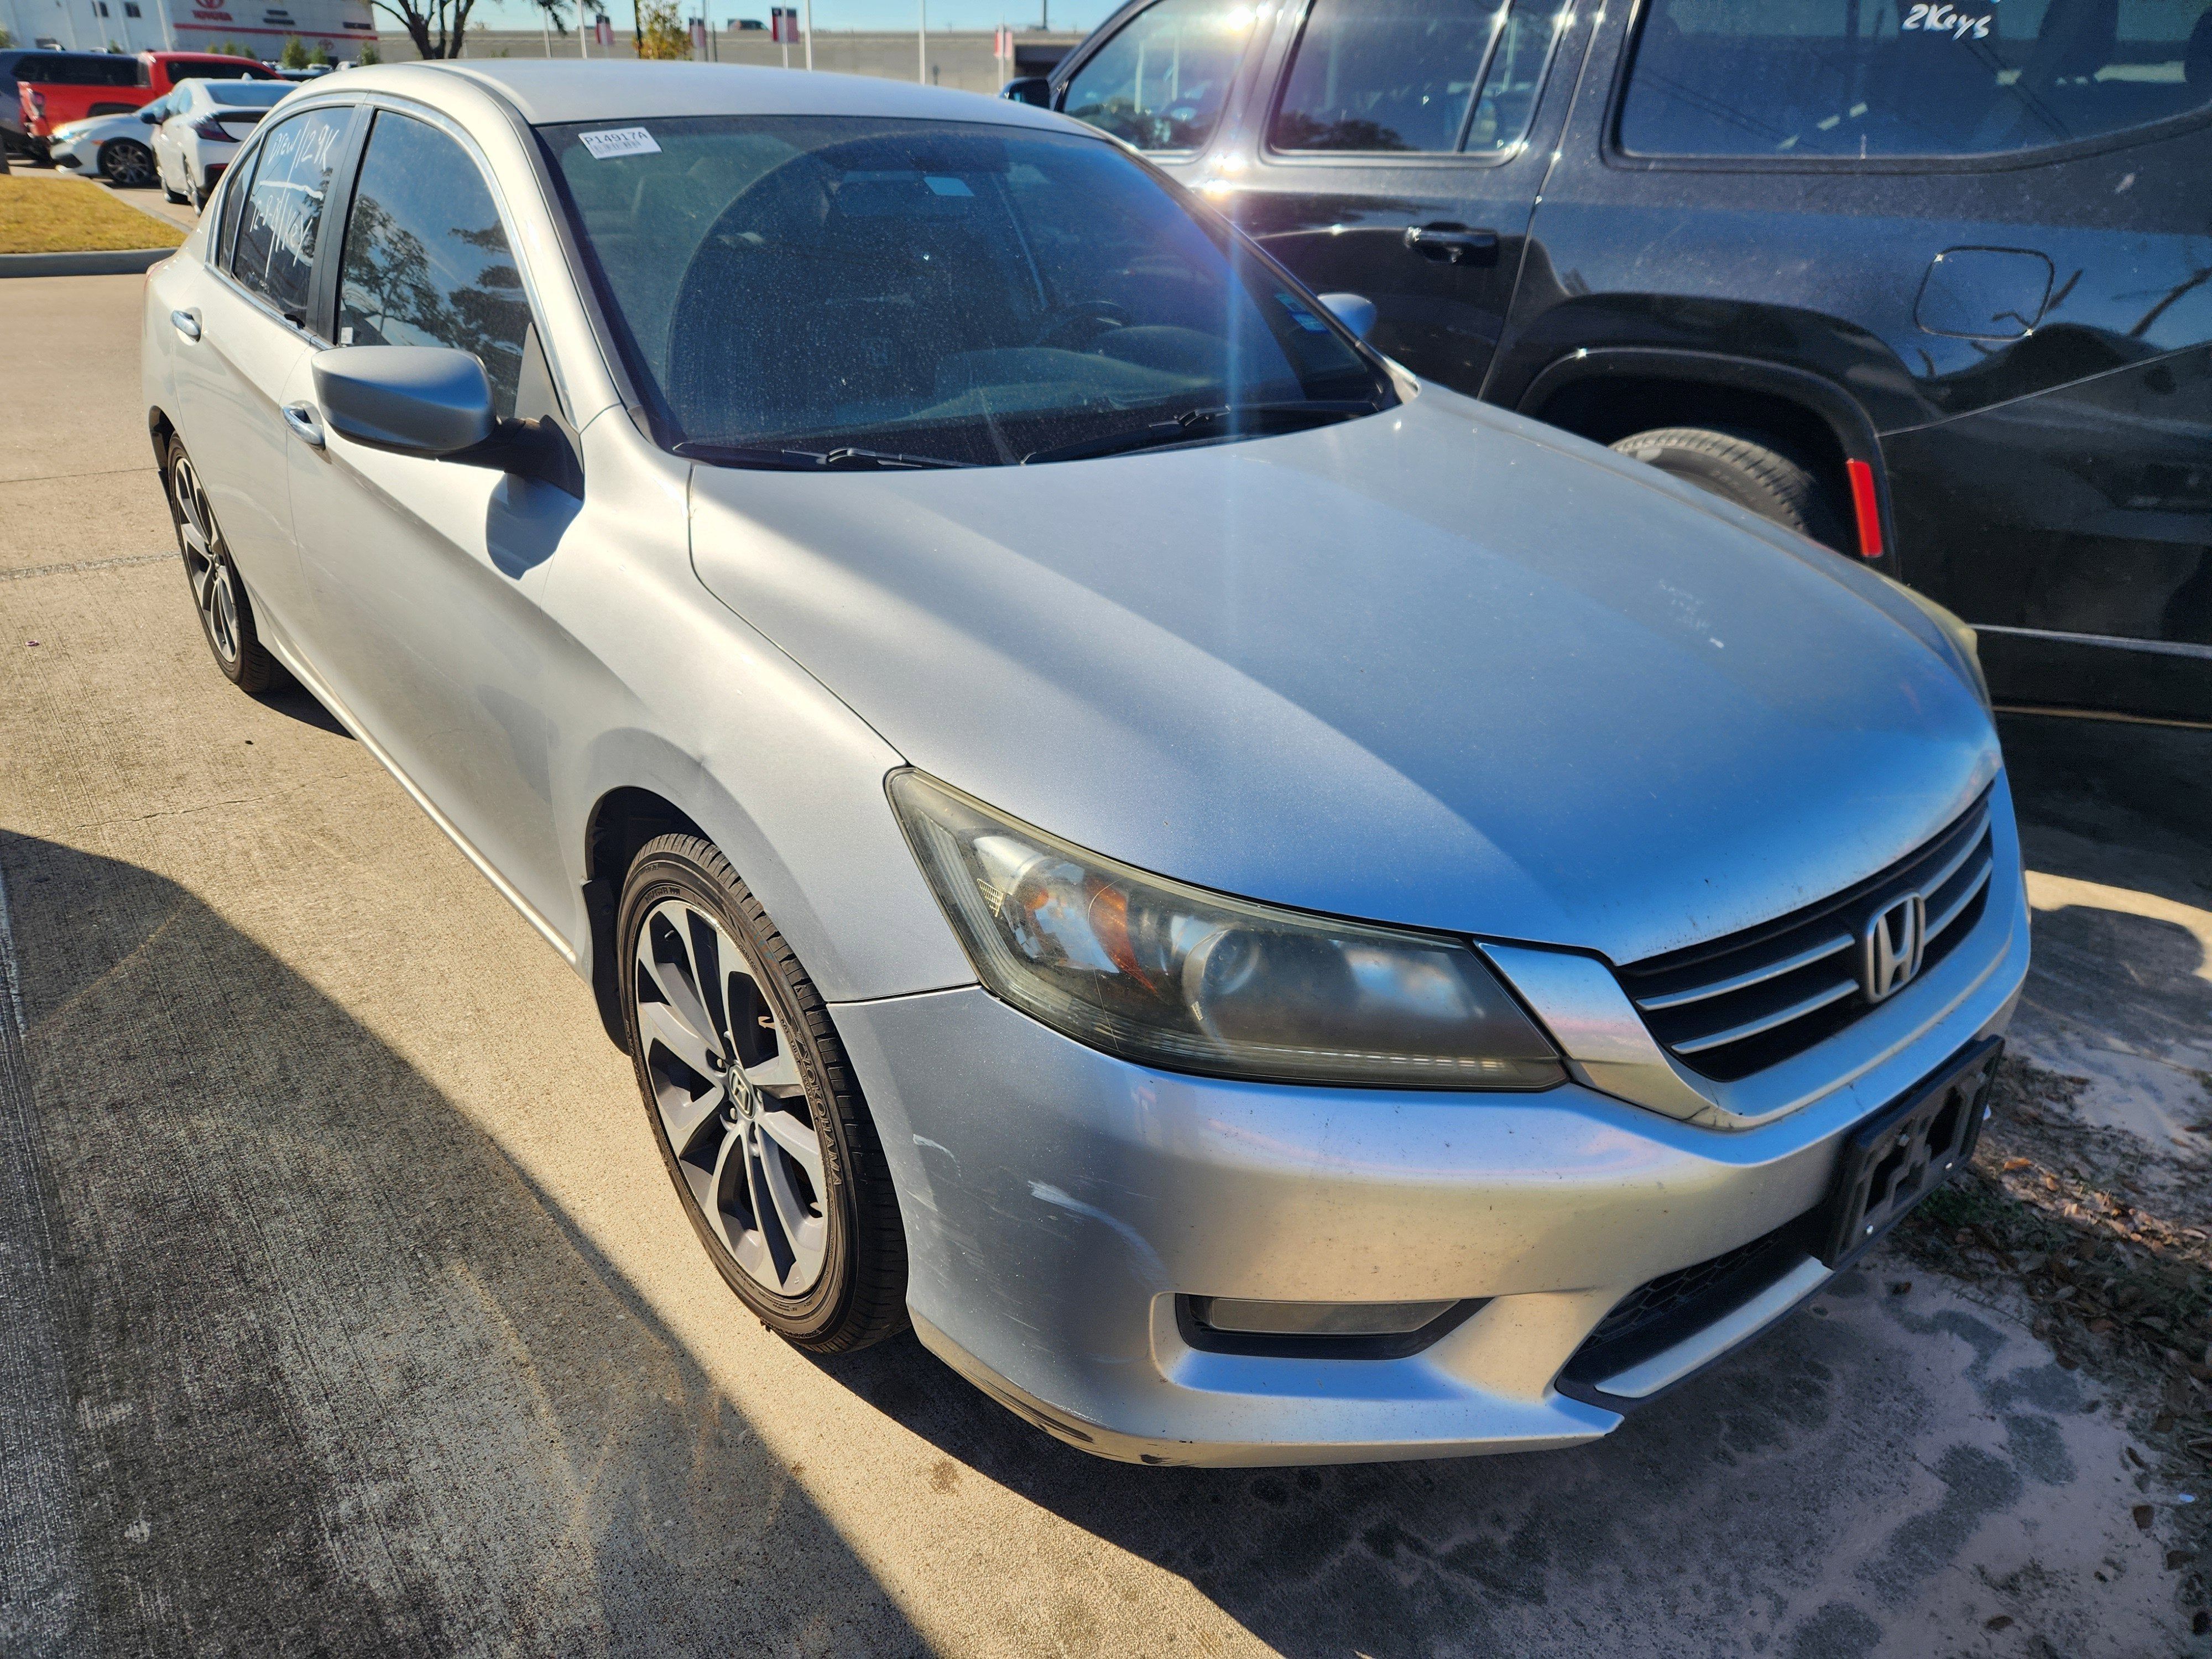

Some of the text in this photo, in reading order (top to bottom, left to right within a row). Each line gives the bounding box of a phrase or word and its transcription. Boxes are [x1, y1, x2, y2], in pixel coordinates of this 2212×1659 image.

[1902, 3, 1992, 41] 2Keys
[583, 131, 649, 145] P14917A
[801, 1051, 842, 1186] YOKOHAMA
